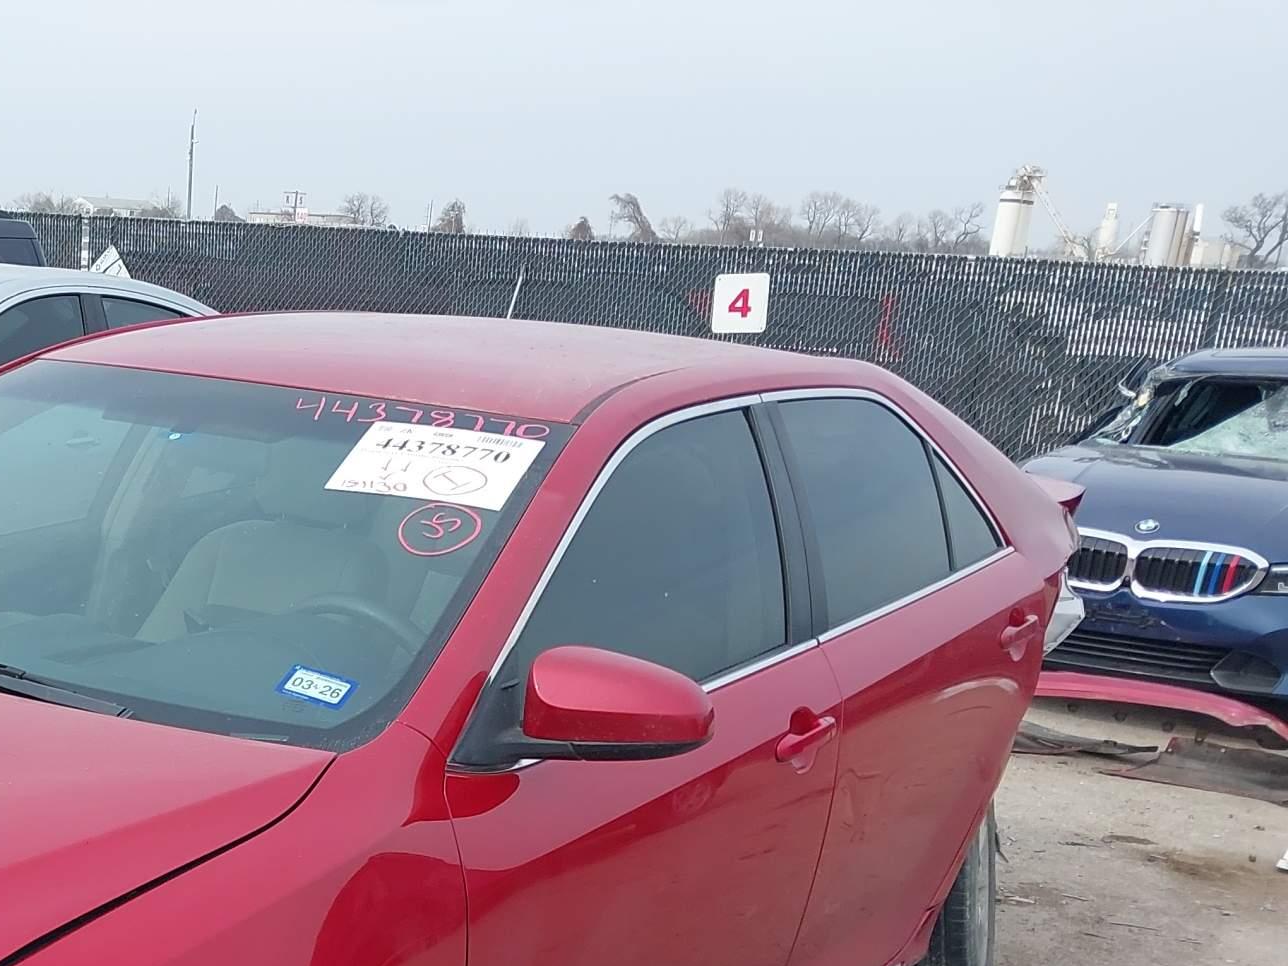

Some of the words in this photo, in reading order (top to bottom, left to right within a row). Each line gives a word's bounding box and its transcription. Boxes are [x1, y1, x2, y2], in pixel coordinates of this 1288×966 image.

[728, 288, 752, 318] 4
[296, 396, 550, 438] 44378770
[376, 438, 511, 463] 44378770
[291, 677, 314, 690] 03
[319, 685, 343, 699] 26
